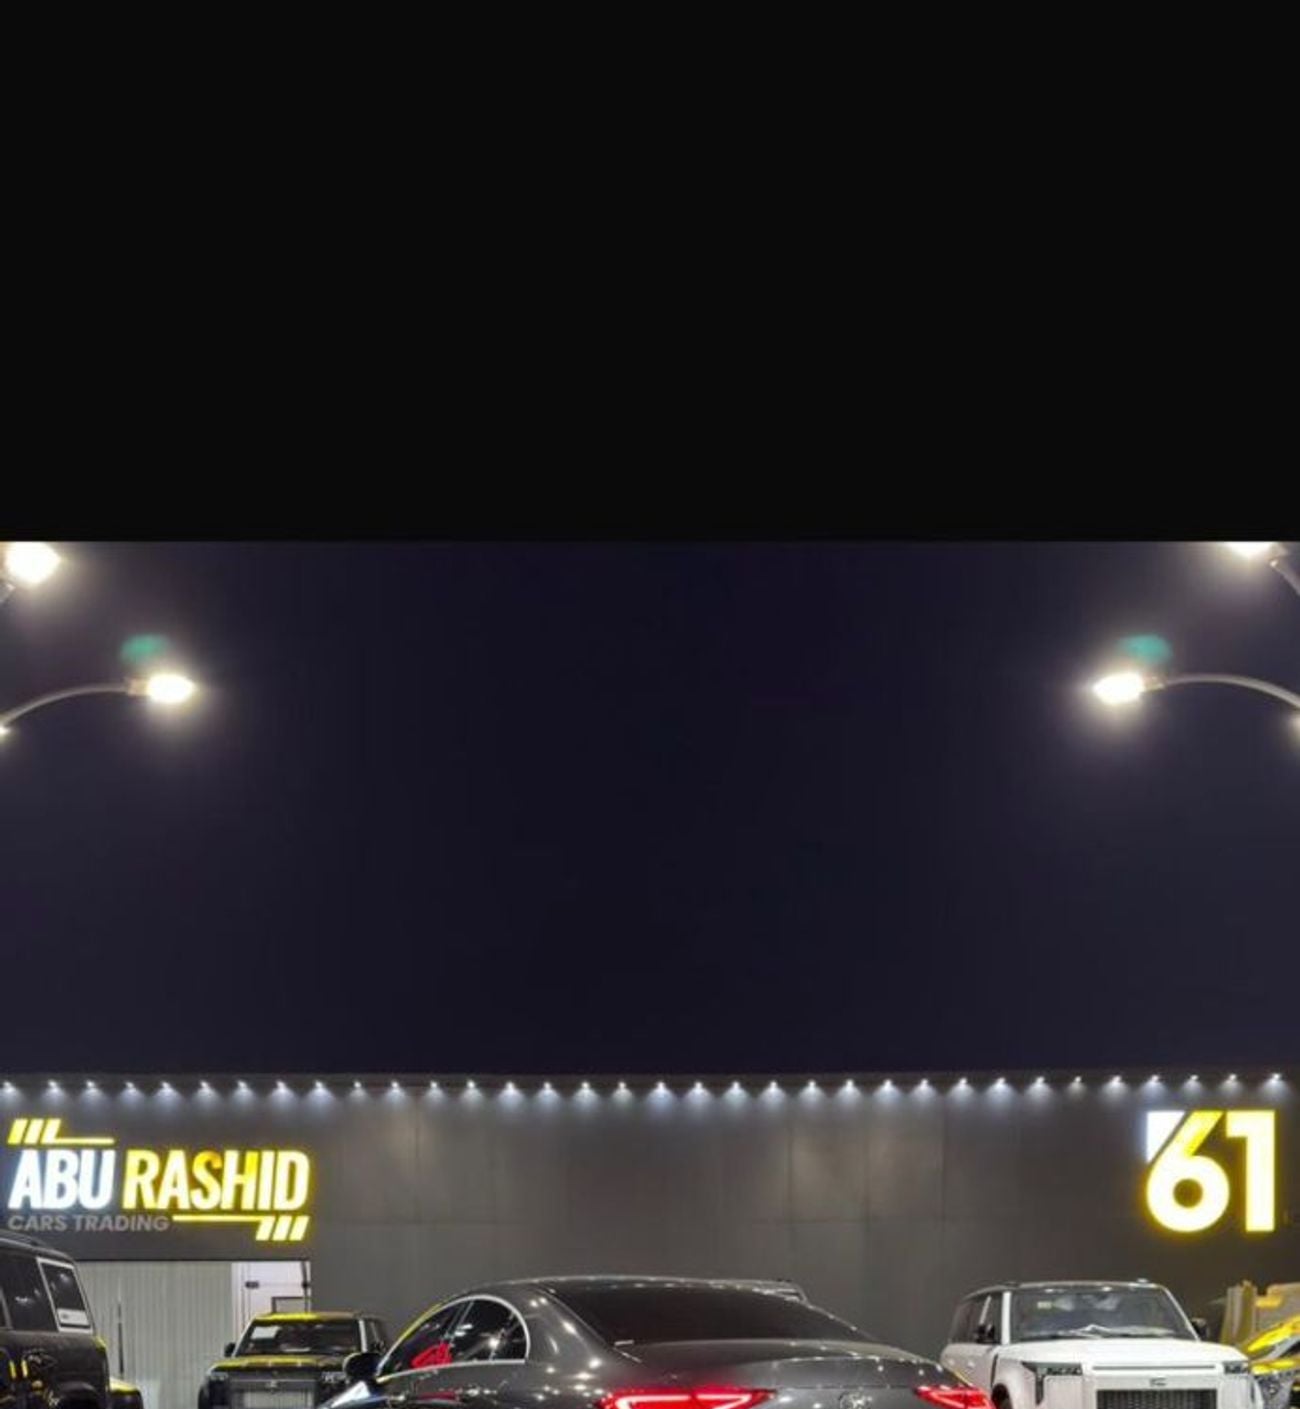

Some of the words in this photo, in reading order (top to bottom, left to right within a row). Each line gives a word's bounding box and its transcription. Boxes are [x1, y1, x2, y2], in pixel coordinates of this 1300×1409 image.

[8, 1149, 114, 1209] ABU
[123, 1150, 310, 1211] RASHID
[1146, 1110, 1275, 1232] 61
[8, 1215, 69, 1232] CARS
[75, 1215, 170, 1232] TRADING
